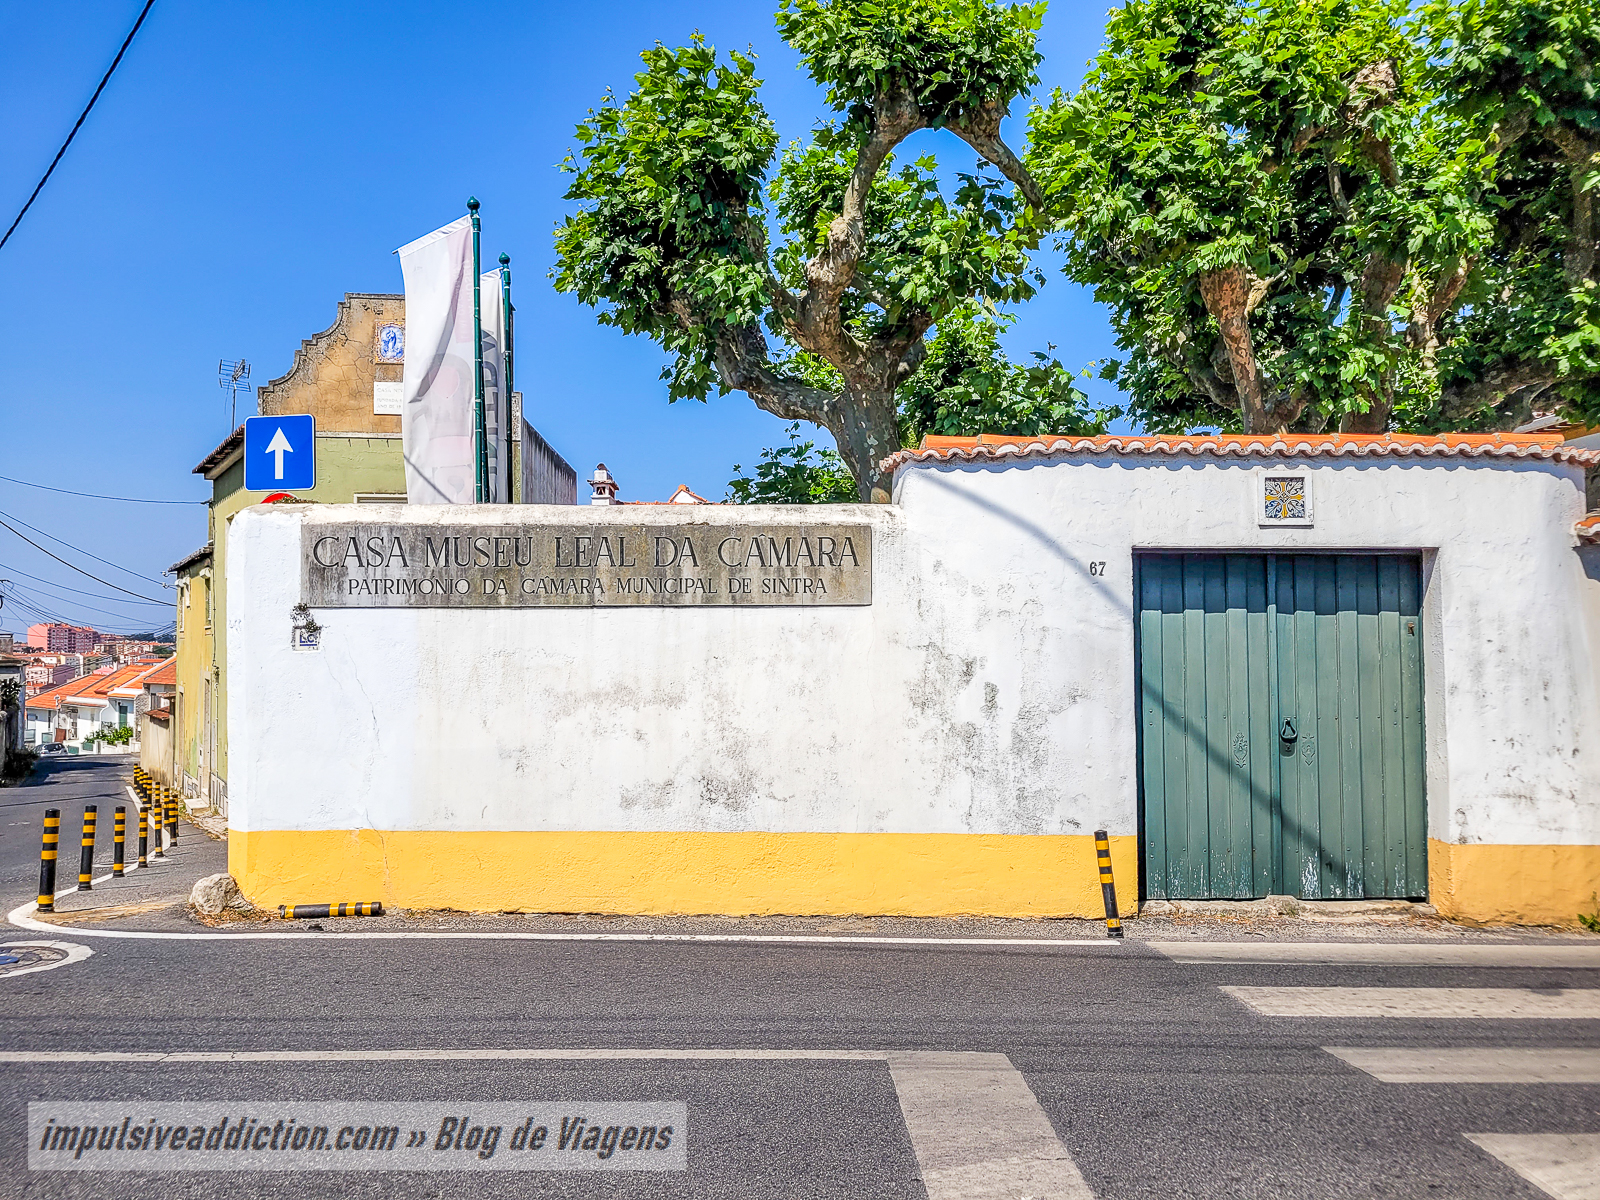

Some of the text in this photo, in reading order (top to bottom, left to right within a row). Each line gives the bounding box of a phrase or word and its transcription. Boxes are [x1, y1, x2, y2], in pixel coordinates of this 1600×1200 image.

[313, 533, 860, 568] CASA MUSEU LEAL DA CÂMARA
[1089, 560, 1106, 577] 67
[348, 575, 828, 595] PATRIMÓNIO DA CÂMARA MUNICIPAL DE SINTRA
